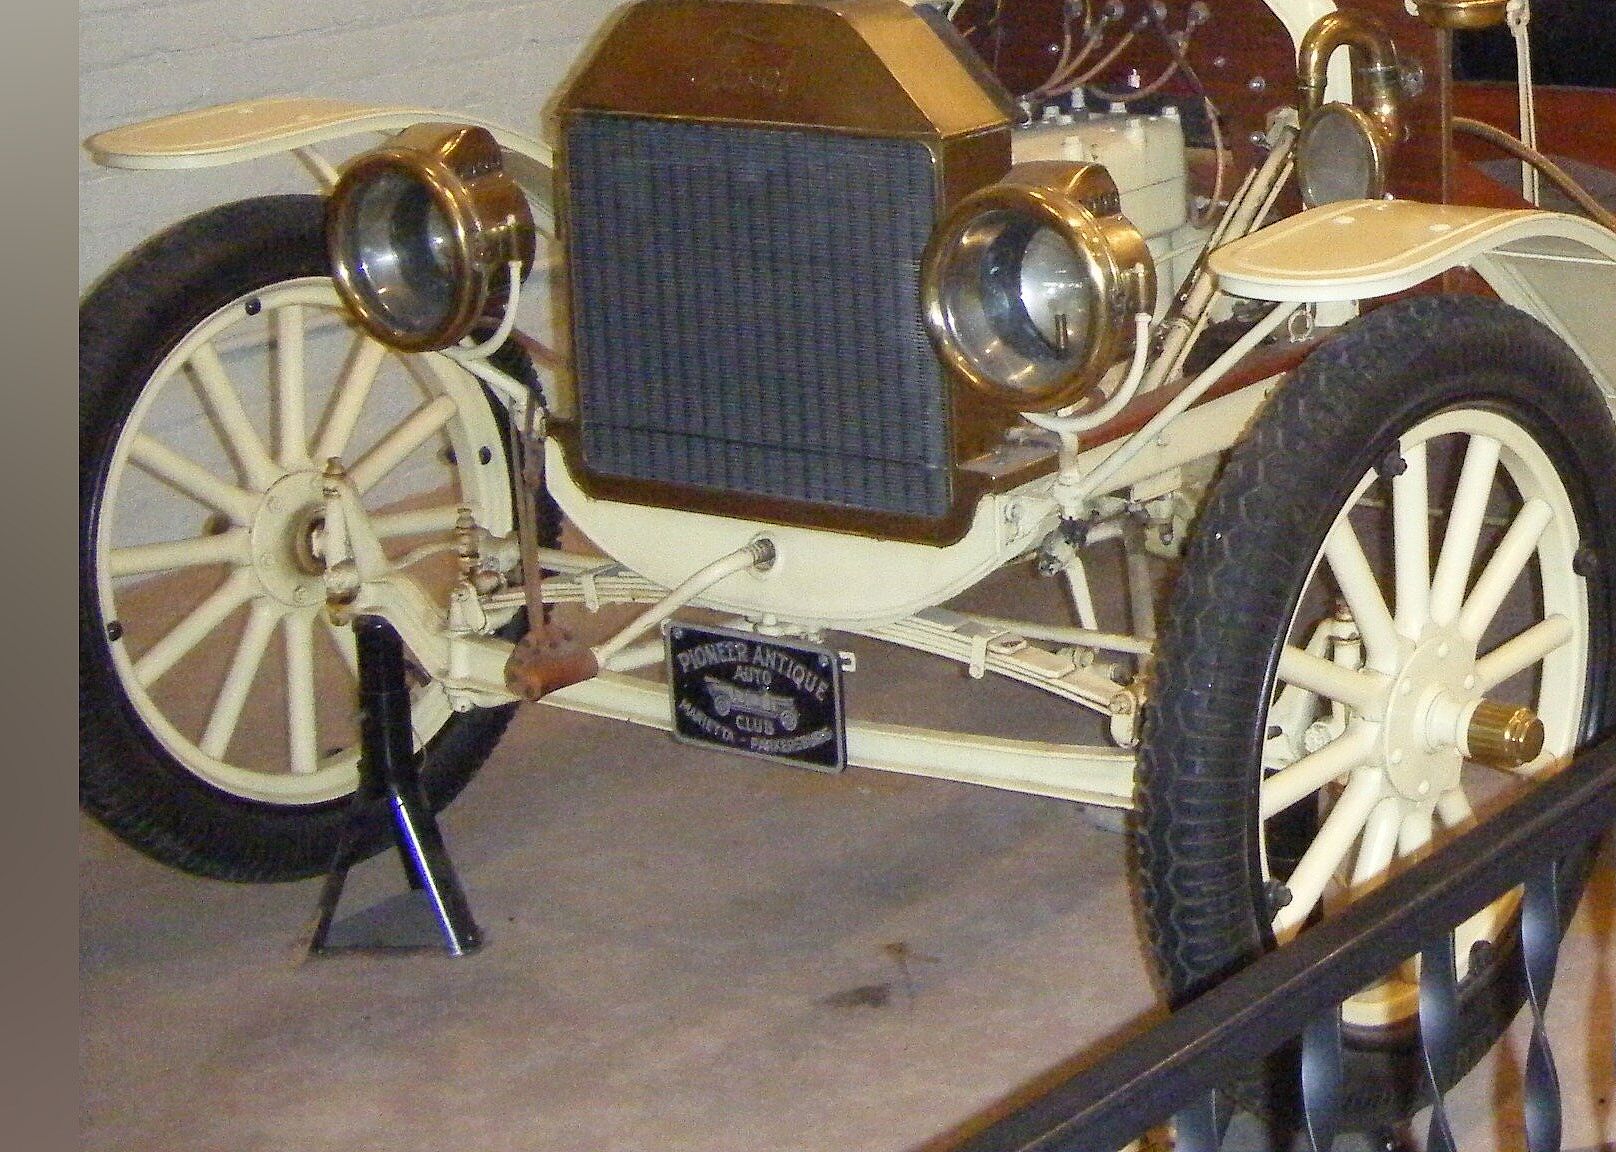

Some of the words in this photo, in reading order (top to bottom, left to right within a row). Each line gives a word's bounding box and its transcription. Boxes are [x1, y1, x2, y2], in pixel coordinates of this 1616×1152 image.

[677, 641, 748, 673] PIONEER
[753, 646, 829, 701] ANTIQUE
[733, 665, 772, 687] AUTO
[735, 714, 775, 736] CLUB
